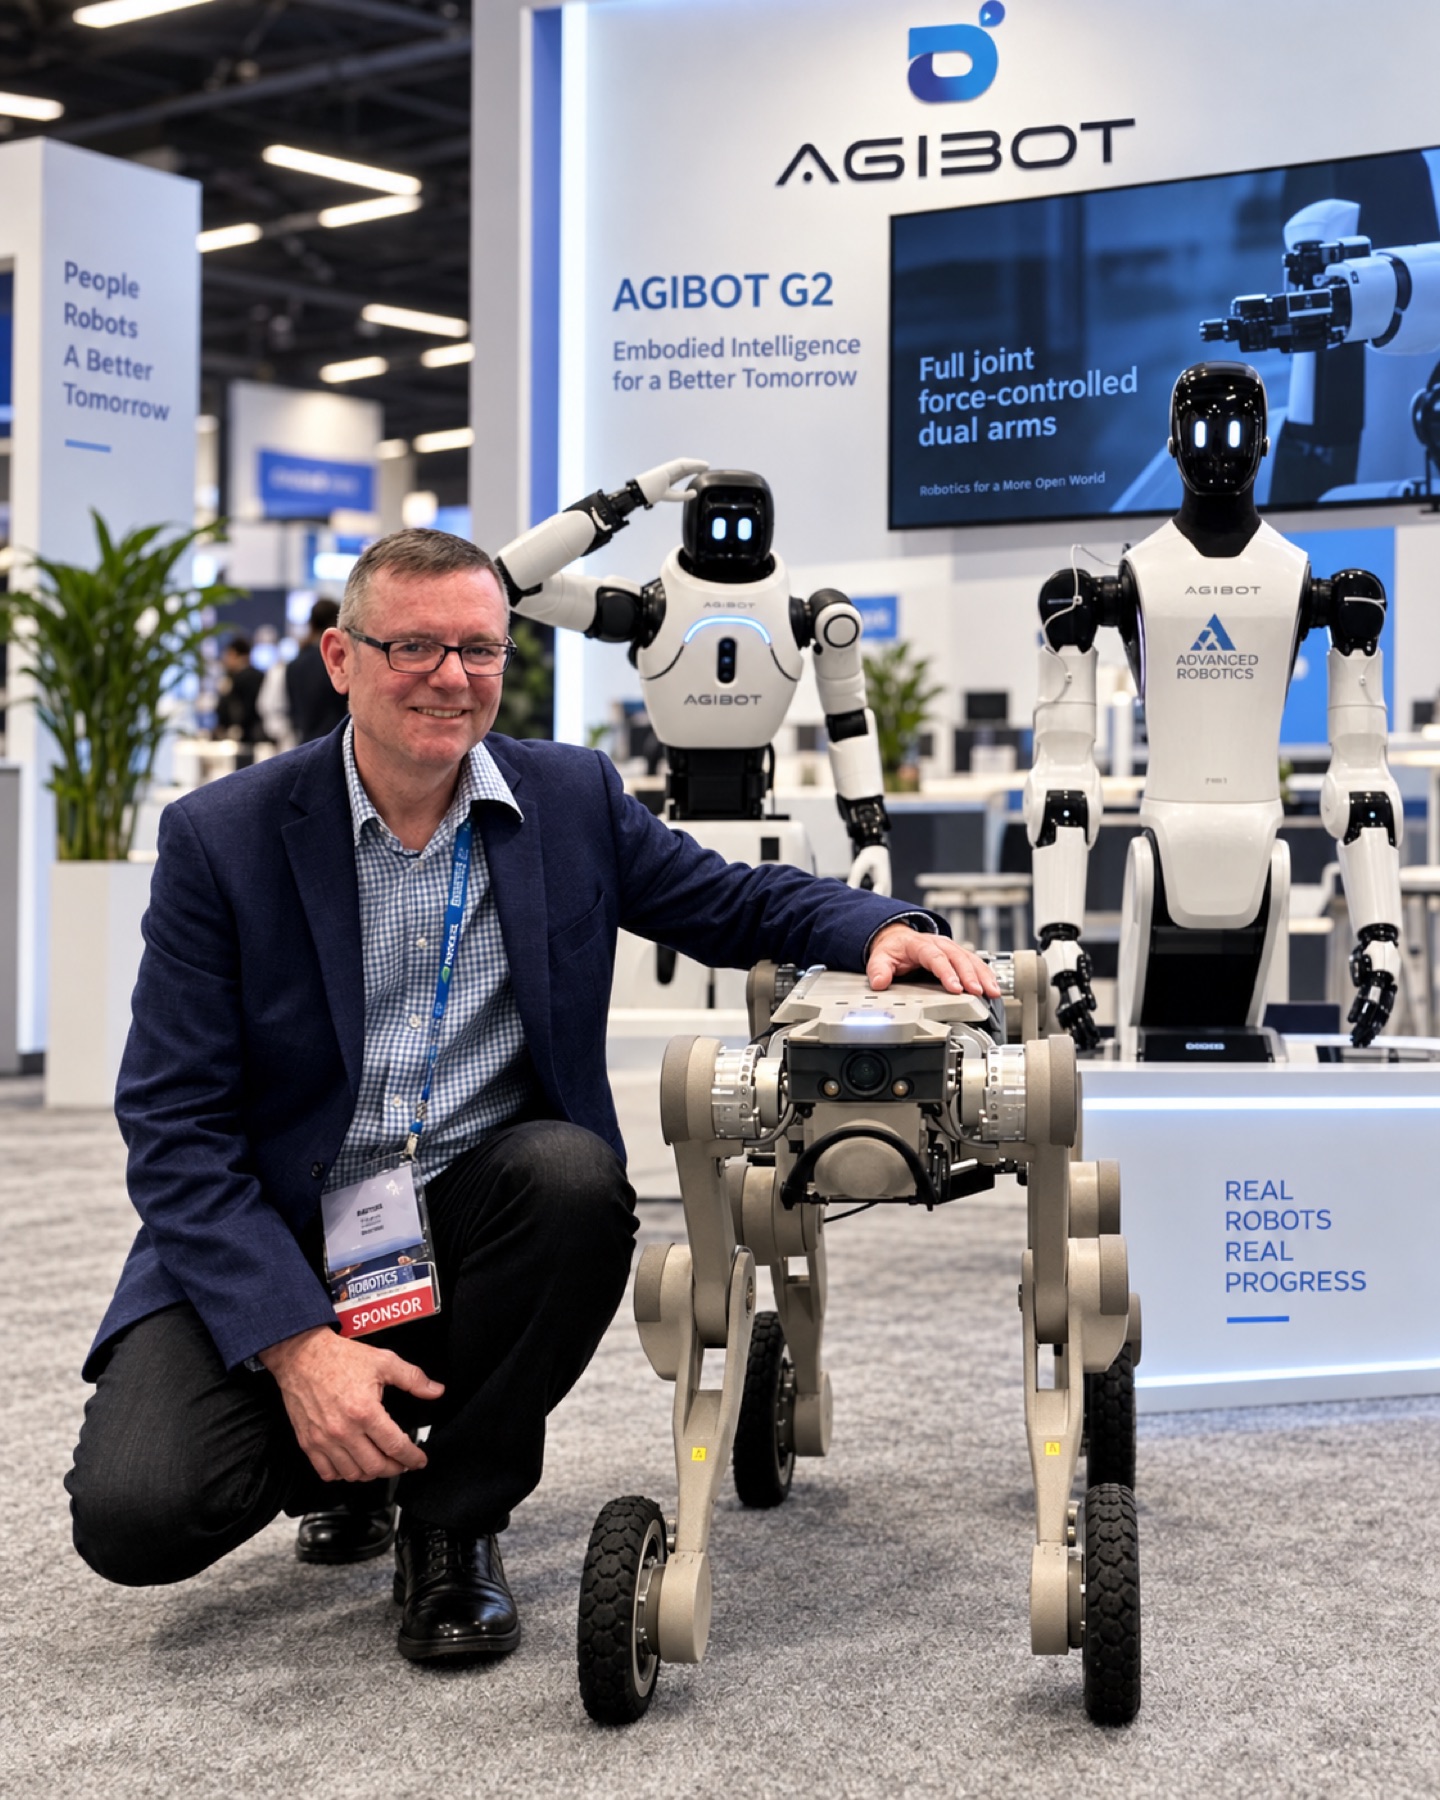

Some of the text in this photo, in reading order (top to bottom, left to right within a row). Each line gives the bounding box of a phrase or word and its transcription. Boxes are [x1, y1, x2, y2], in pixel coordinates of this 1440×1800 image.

[775, 117, 1136, 187] AGIBOT
[64, 260, 140, 300] People
[612, 271, 833, 312] AGIBOT G2
[64, 301, 139, 340] Robots
[63, 343, 153, 381] A Better
[613, 334, 861, 362] Embodied Intelligence
[919, 346, 1035, 383] Full joint
[613, 367, 858, 391] for a Better Tomorrow
[918, 365, 1138, 414] force-controlled
[62, 381, 170, 422] Tomorrow
[918, 415, 1058, 447] dual arms
[919, 471, 1106, 497] Robotics for a More Open World
[1184, 586, 1261, 596] AGIBOT
[1176, 654, 1259, 666] ADVANCED
[1176, 668, 1254, 680] ROBOTICS
[683, 694, 762, 706] AGIBOT
[1225, 1179, 1294, 1202] REAL
[1225, 1209, 1332, 1232] ROBOTS
[1225, 1240, 1294, 1263] REAL
[1225, 1270, 1367, 1293] PROGRESS
[352, 1297, 423, 1330] SPONSOR
